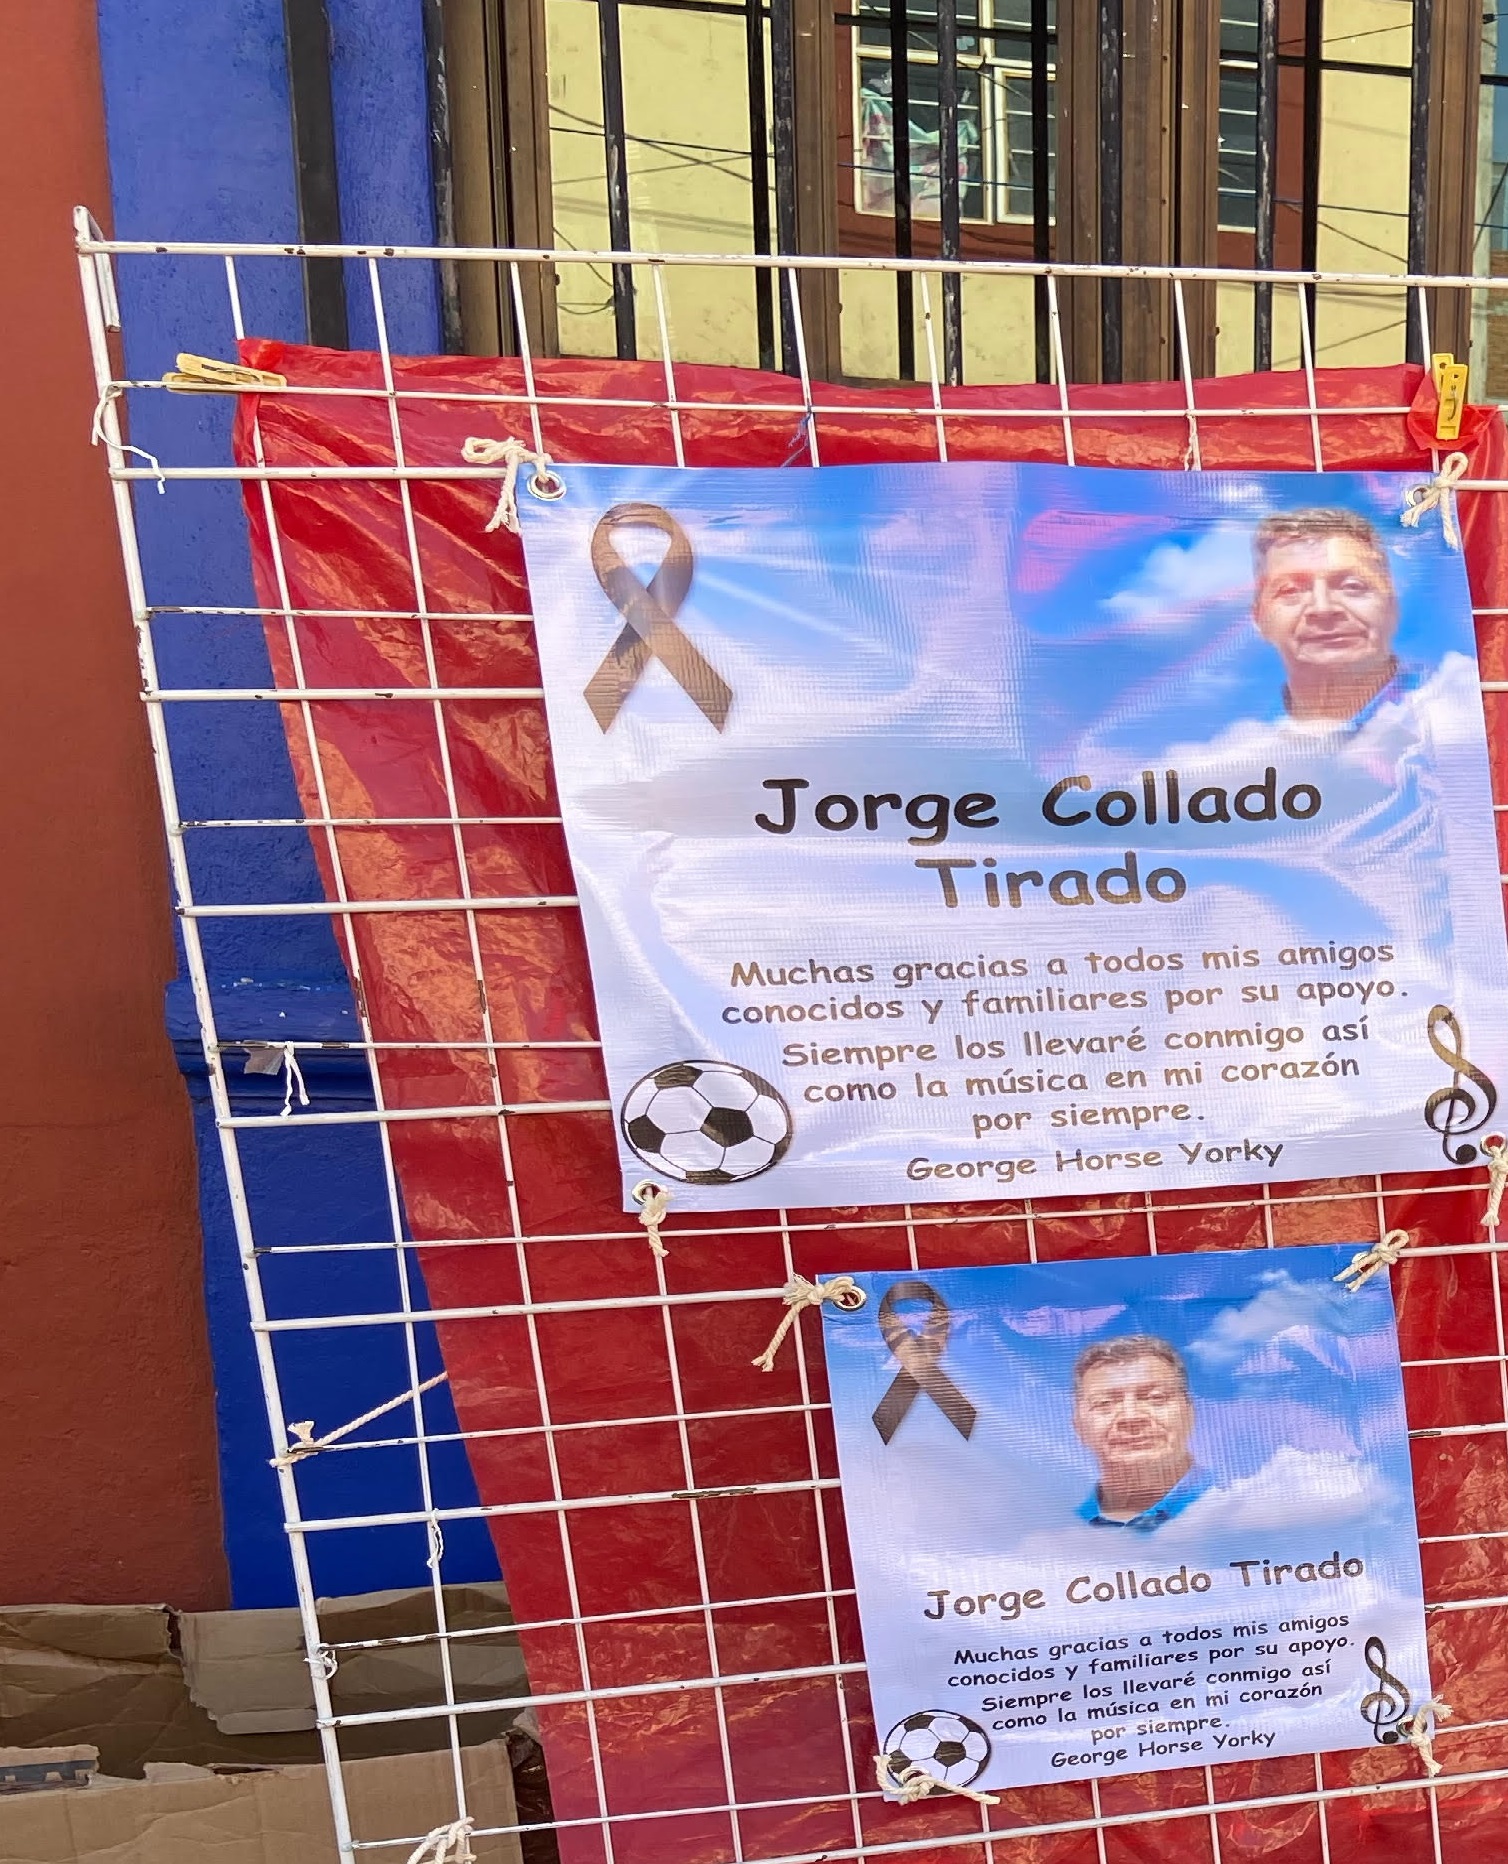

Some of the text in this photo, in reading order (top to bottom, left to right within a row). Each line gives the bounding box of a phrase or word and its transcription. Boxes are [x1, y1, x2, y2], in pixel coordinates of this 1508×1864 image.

[754, 767, 1323, 846] Jorge Collado
[915, 851, 1187, 909] Tirado
[731, 940, 1394, 989] Muchas gracias a todos mis amigos
[722, 978, 1408, 1025] conocidos y familiares por su apoyo.
[782, 1015, 1369, 1071] Siempre los llevaré conmigo así
[804, 1053, 1359, 1103] como la música en mi corazón
[973, 1102, 1205, 1139] por siempre.
[906, 1139, 1283, 1183] George Horse Yorky
[924, 1550, 1364, 1620] Jorge Collado Tirado
[947, 1636, 1355, 1687] conocidos y familiares por su apoyo.
[954, 1613, 1349, 1664] Muchas gracias a todos mis amigos
[982, 1658, 1331, 1711] Siempre los llevaré conmigo así
[992, 1682, 1323, 1730] como la música en mi corazón
[1050, 1729, 1276, 1768] George Horse Yorky
[1091, 1715, 1230, 1746] por siempre.
